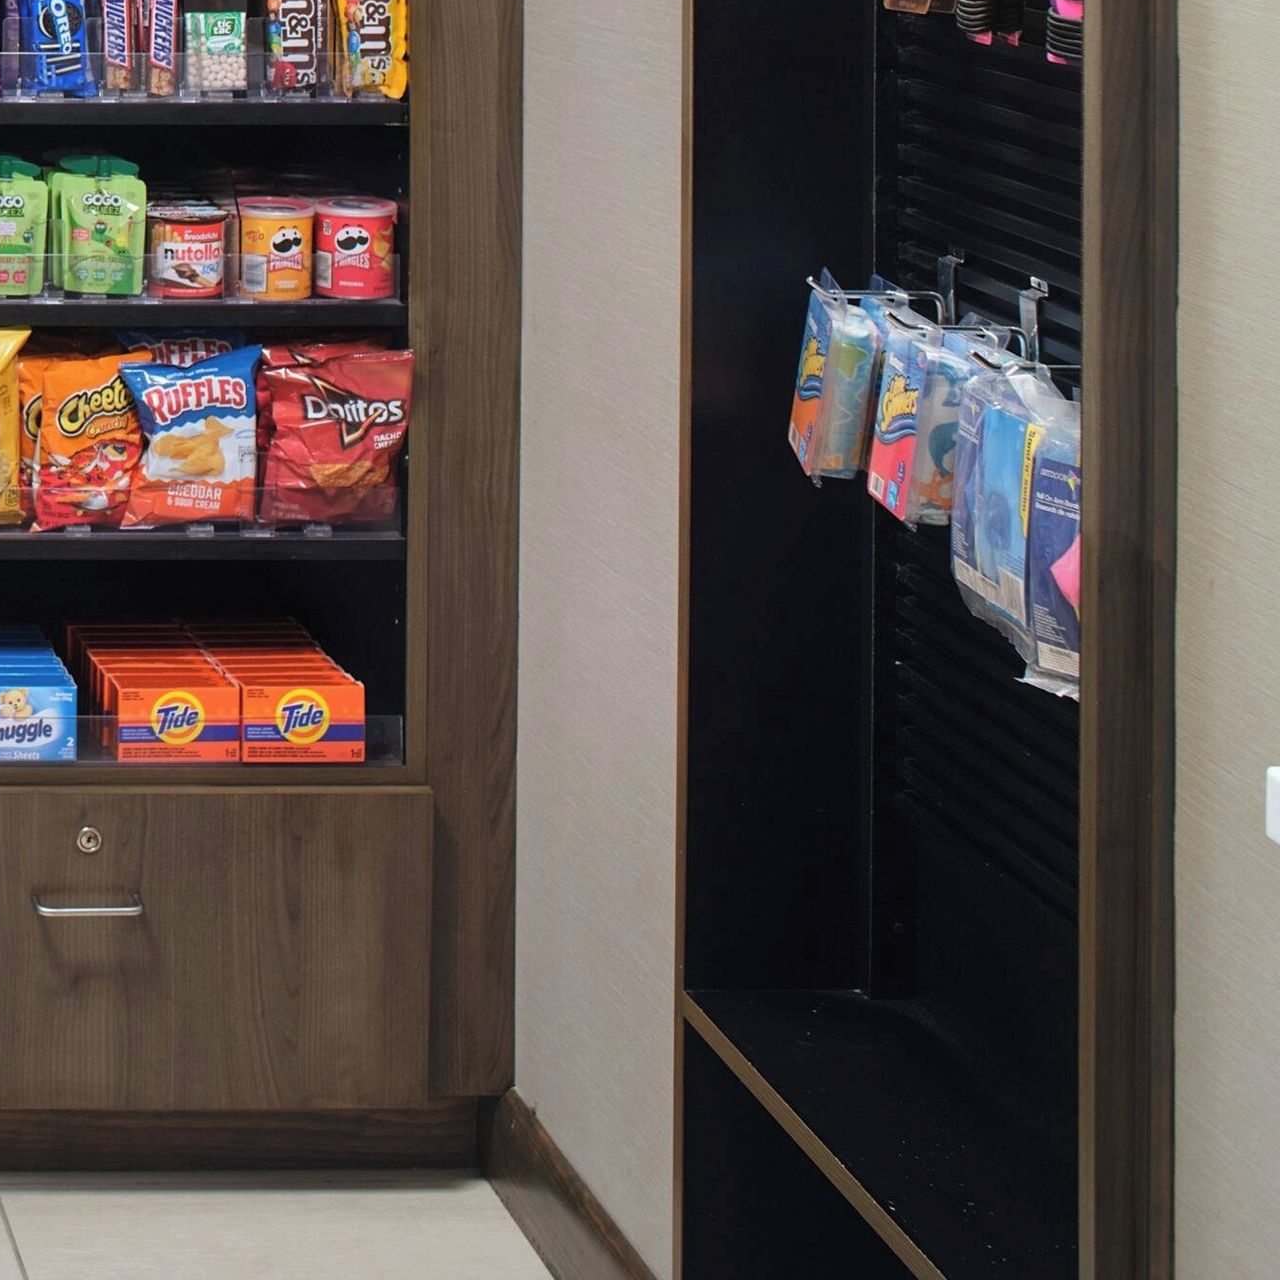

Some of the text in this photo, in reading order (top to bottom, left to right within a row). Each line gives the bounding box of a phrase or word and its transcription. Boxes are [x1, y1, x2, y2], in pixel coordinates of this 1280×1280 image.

[213, 26, 232, 35] tac
[217, 19, 233, 28] tic
[82, 192, 122, 207] GOGO
[164, 244, 223, 261] nutella
[334, 252, 370, 269] PRINGLES
[143, 376, 247, 425] RUFFLES
[304, 394, 404, 421] Doritos
[167, 484, 222, 499] CHEDDAR
[174, 498, 193, 508] SOUR
[195, 499, 220, 511] CREAM
[156, 704, 200, 736] Tide
[280, 702, 324, 735] Tide
[66, 737, 75, 746] 2
[13, 749, 40, 760] Sheets
